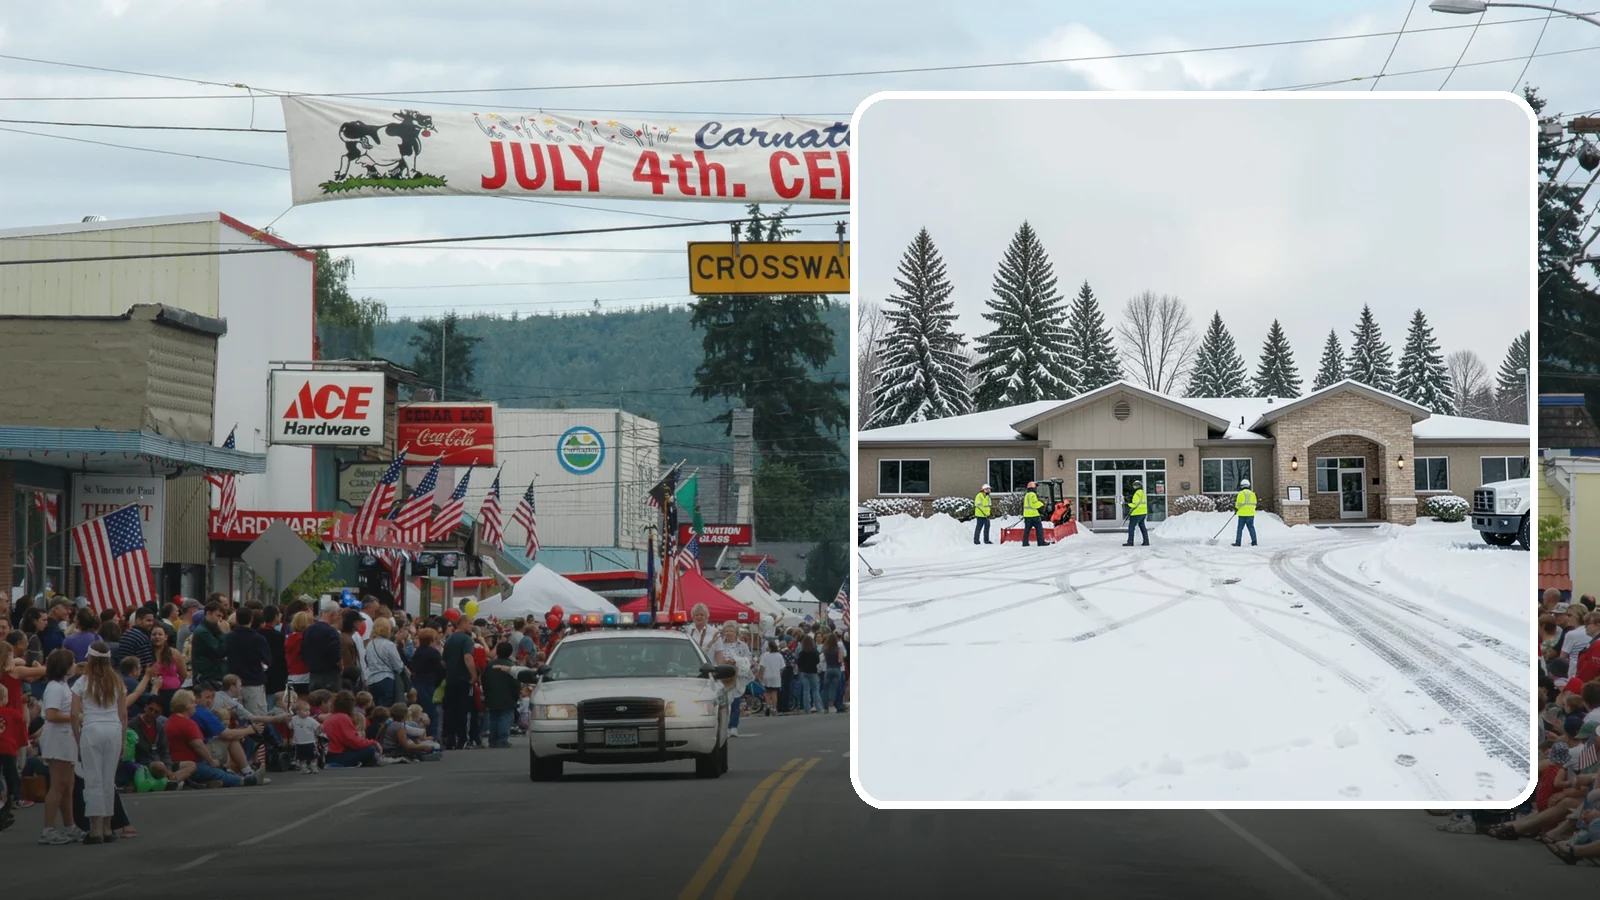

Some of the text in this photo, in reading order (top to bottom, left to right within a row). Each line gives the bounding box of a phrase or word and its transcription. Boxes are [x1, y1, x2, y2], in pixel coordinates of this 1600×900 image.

[481, 141, 605, 193] JULY
[632, 149, 746, 198] 4th.
[697, 253, 850, 280] CROSSWA
[283, 380, 373, 420] ACE
[406, 409, 486, 422] CEDAR LOG
[283, 421, 371, 436] Hardware
[416, 428, 477, 447] Coca-Cola
[83, 484, 155, 496] St. Vincent de Paul
[688, 526, 741, 535] CRNATION
[699, 535, 730, 543] GLASS
